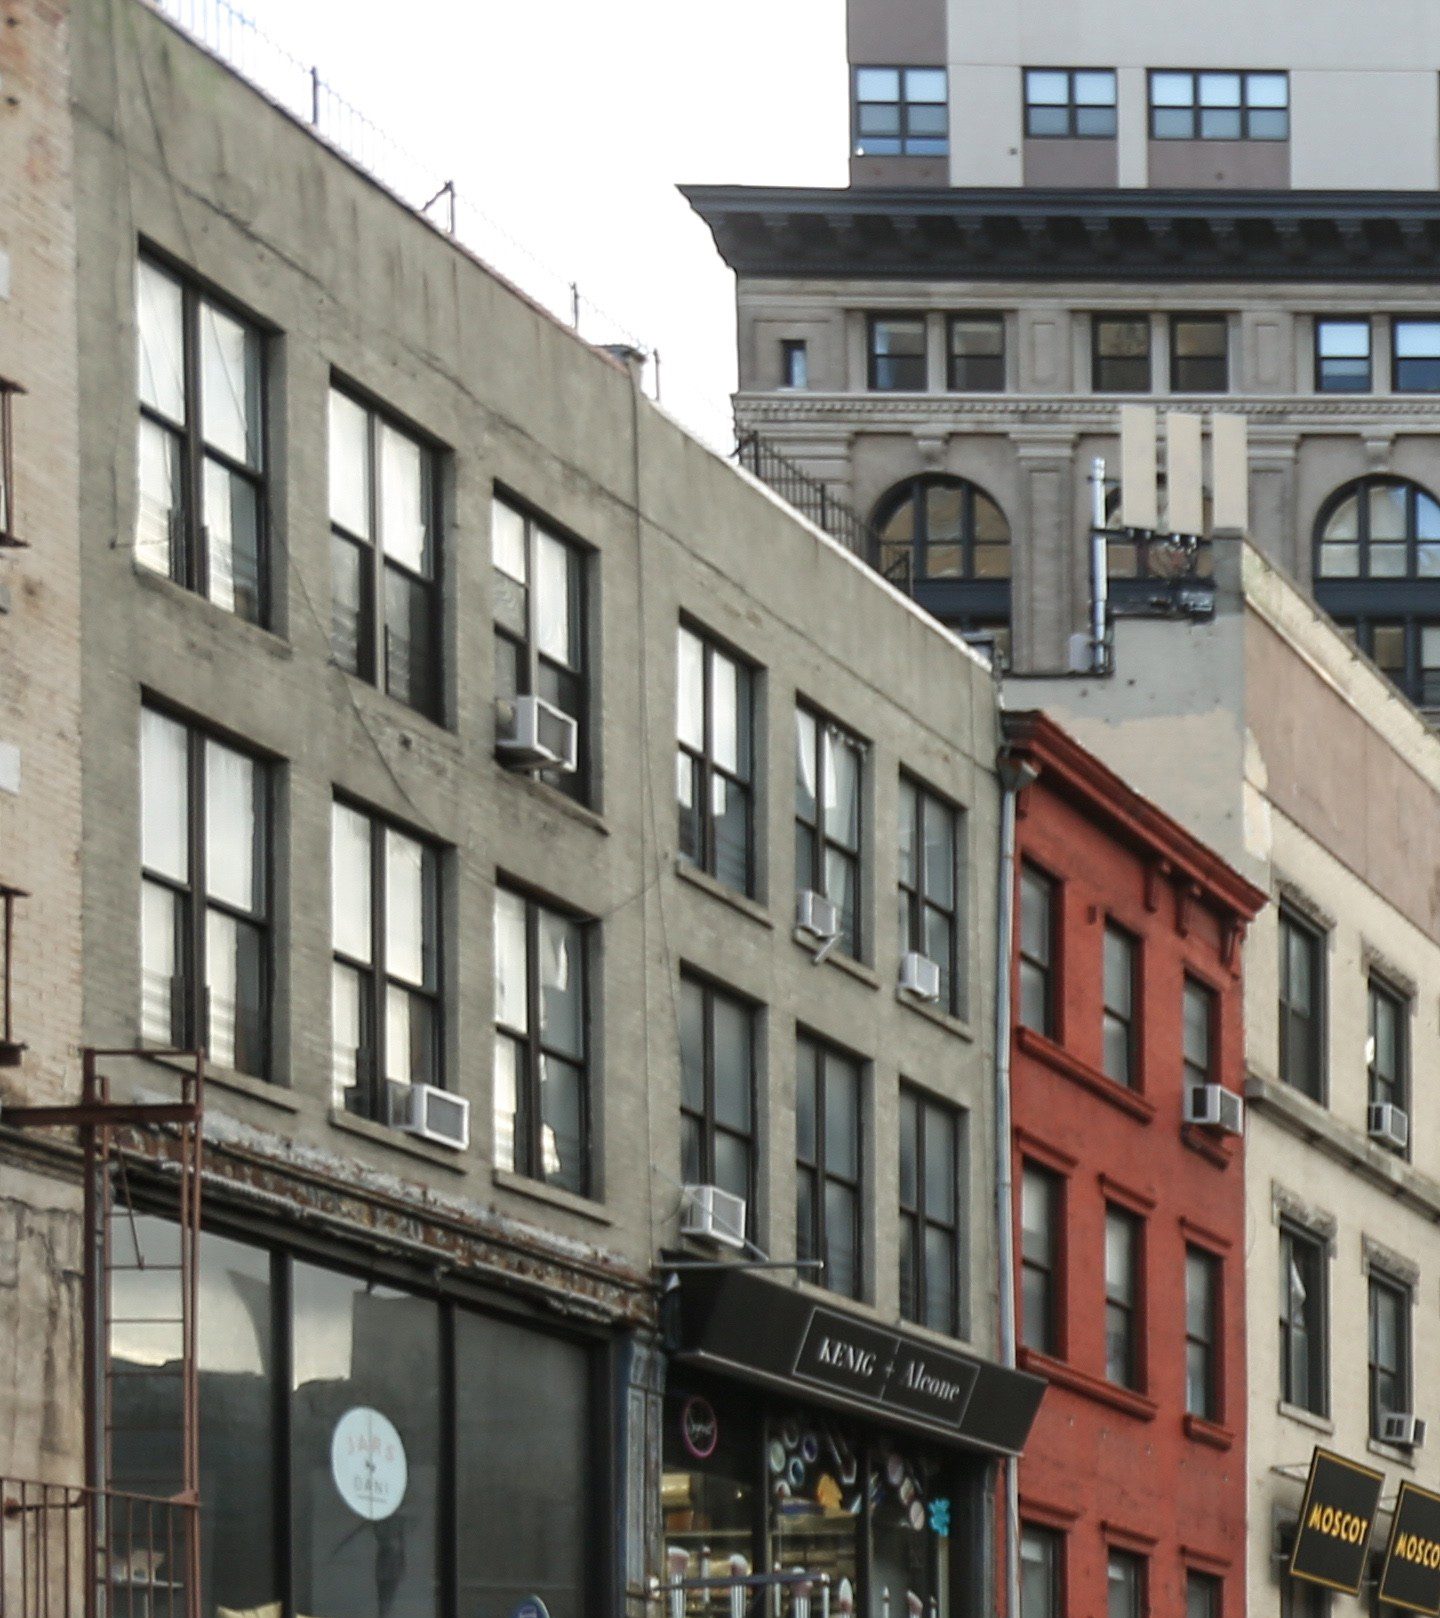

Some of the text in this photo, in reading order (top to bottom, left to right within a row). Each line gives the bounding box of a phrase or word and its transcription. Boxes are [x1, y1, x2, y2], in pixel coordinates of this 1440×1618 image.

[819, 1337, 961, 1403] KENIG Alcone
[1308, 1502, 1369, 1547] MOSCOT
